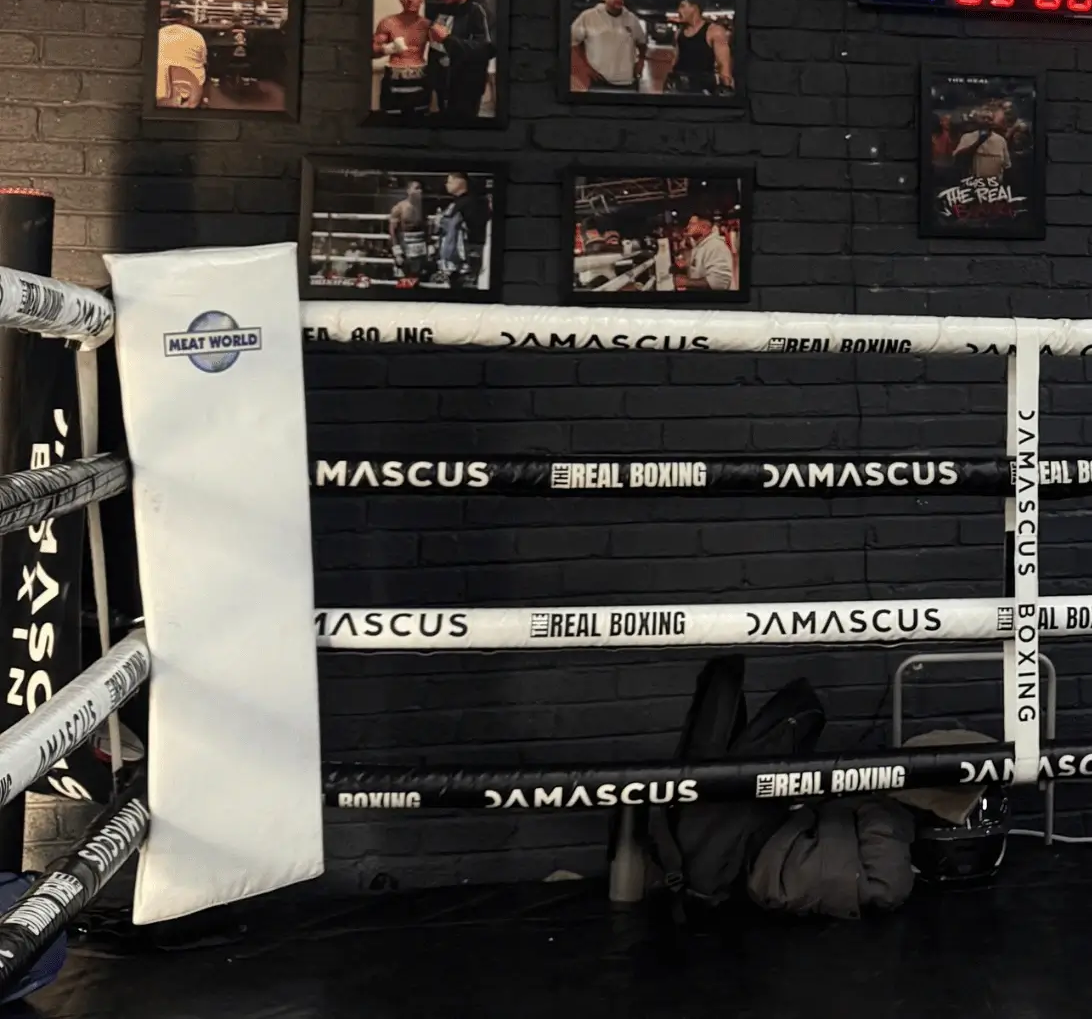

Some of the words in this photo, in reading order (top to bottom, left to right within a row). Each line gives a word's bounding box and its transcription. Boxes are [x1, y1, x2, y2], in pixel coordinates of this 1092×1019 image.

[937, 186, 976, 207] THE
[975, 185, 1028, 204] REAL
[169, 336, 206, 351] MEAT
[209, 333, 258, 349] WORLD
[352, 327, 433, 343] BOING
[500, 331, 710, 350] DAMASCUS
[311, 460, 492, 488] MASCUS
[571, 463, 624, 488] REAL
[629, 462, 707, 487] BOXING
[763, 461, 958, 488] DAMASCUS
[1039, 460, 1072, 485] EAL
[1018, 410, 1036, 576] DAMASCUS
[550, 613, 602, 637] REAL
[609, 611, 686, 636] BOXING
[746, 608, 941, 635] DAMASCUS
[1017, 604, 1036, 723] BOXING
[338, 792, 421, 808] BOXING
[484, 779, 699, 809] DAMASCUS
[774, 771, 825, 797] REAL
[831, 765, 906, 793] BOXING
